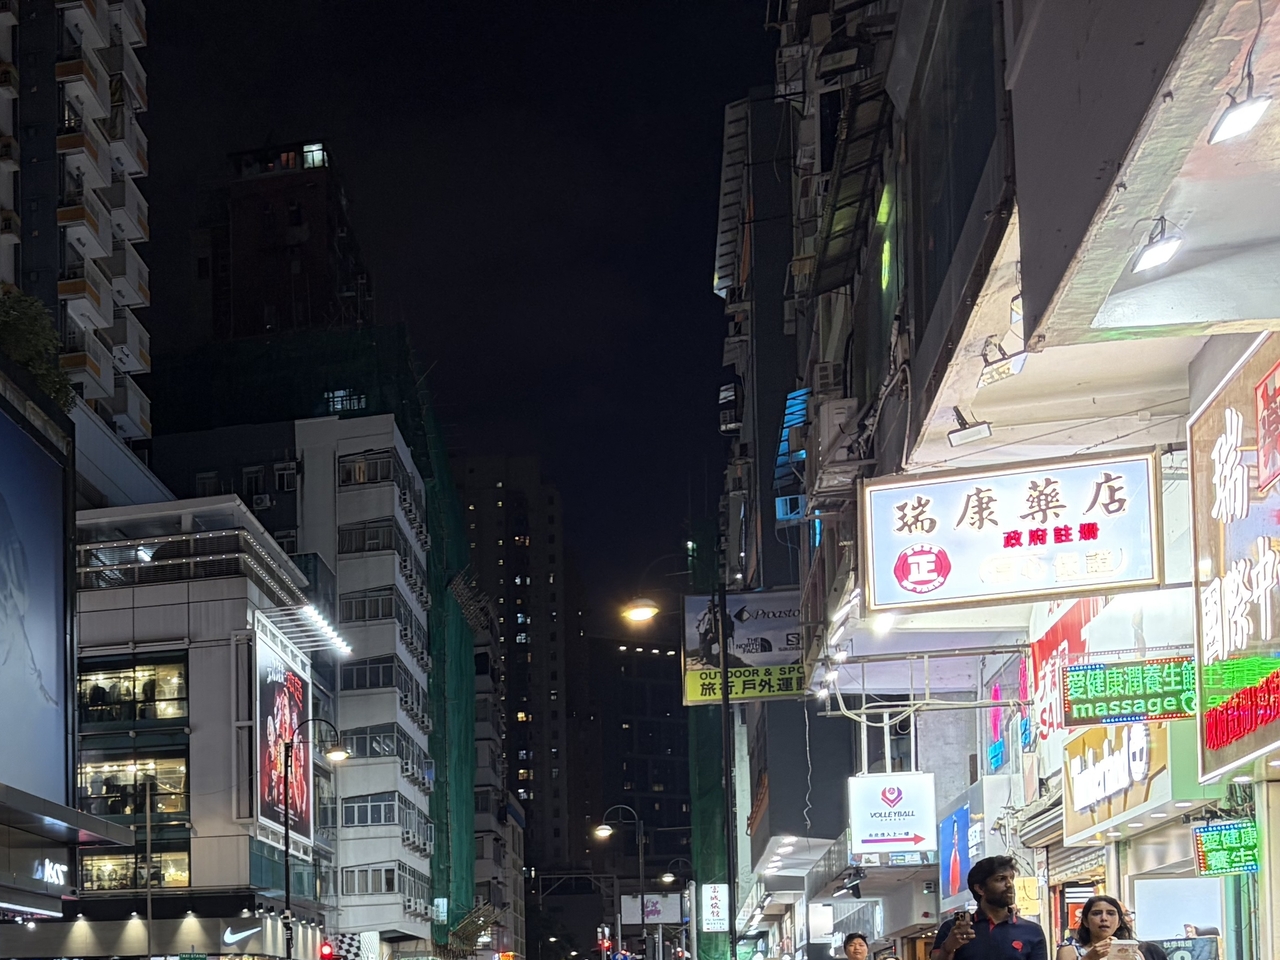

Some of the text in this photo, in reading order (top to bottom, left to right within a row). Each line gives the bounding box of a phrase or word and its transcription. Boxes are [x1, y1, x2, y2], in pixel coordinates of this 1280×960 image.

[893, 472, 1127, 534] 瑞康藥店
[1003, 522, 1100, 548] 政府註冊
[907, 553, 939, 583] 正
[1201, 536, 1280, 666] 國際中
[763, 668, 773, 677] &
[1073, 697, 1177, 719] massage
[869, 810, 916, 819] VOLLEYBALL
[1207, 848, 1258, 871] 養生
